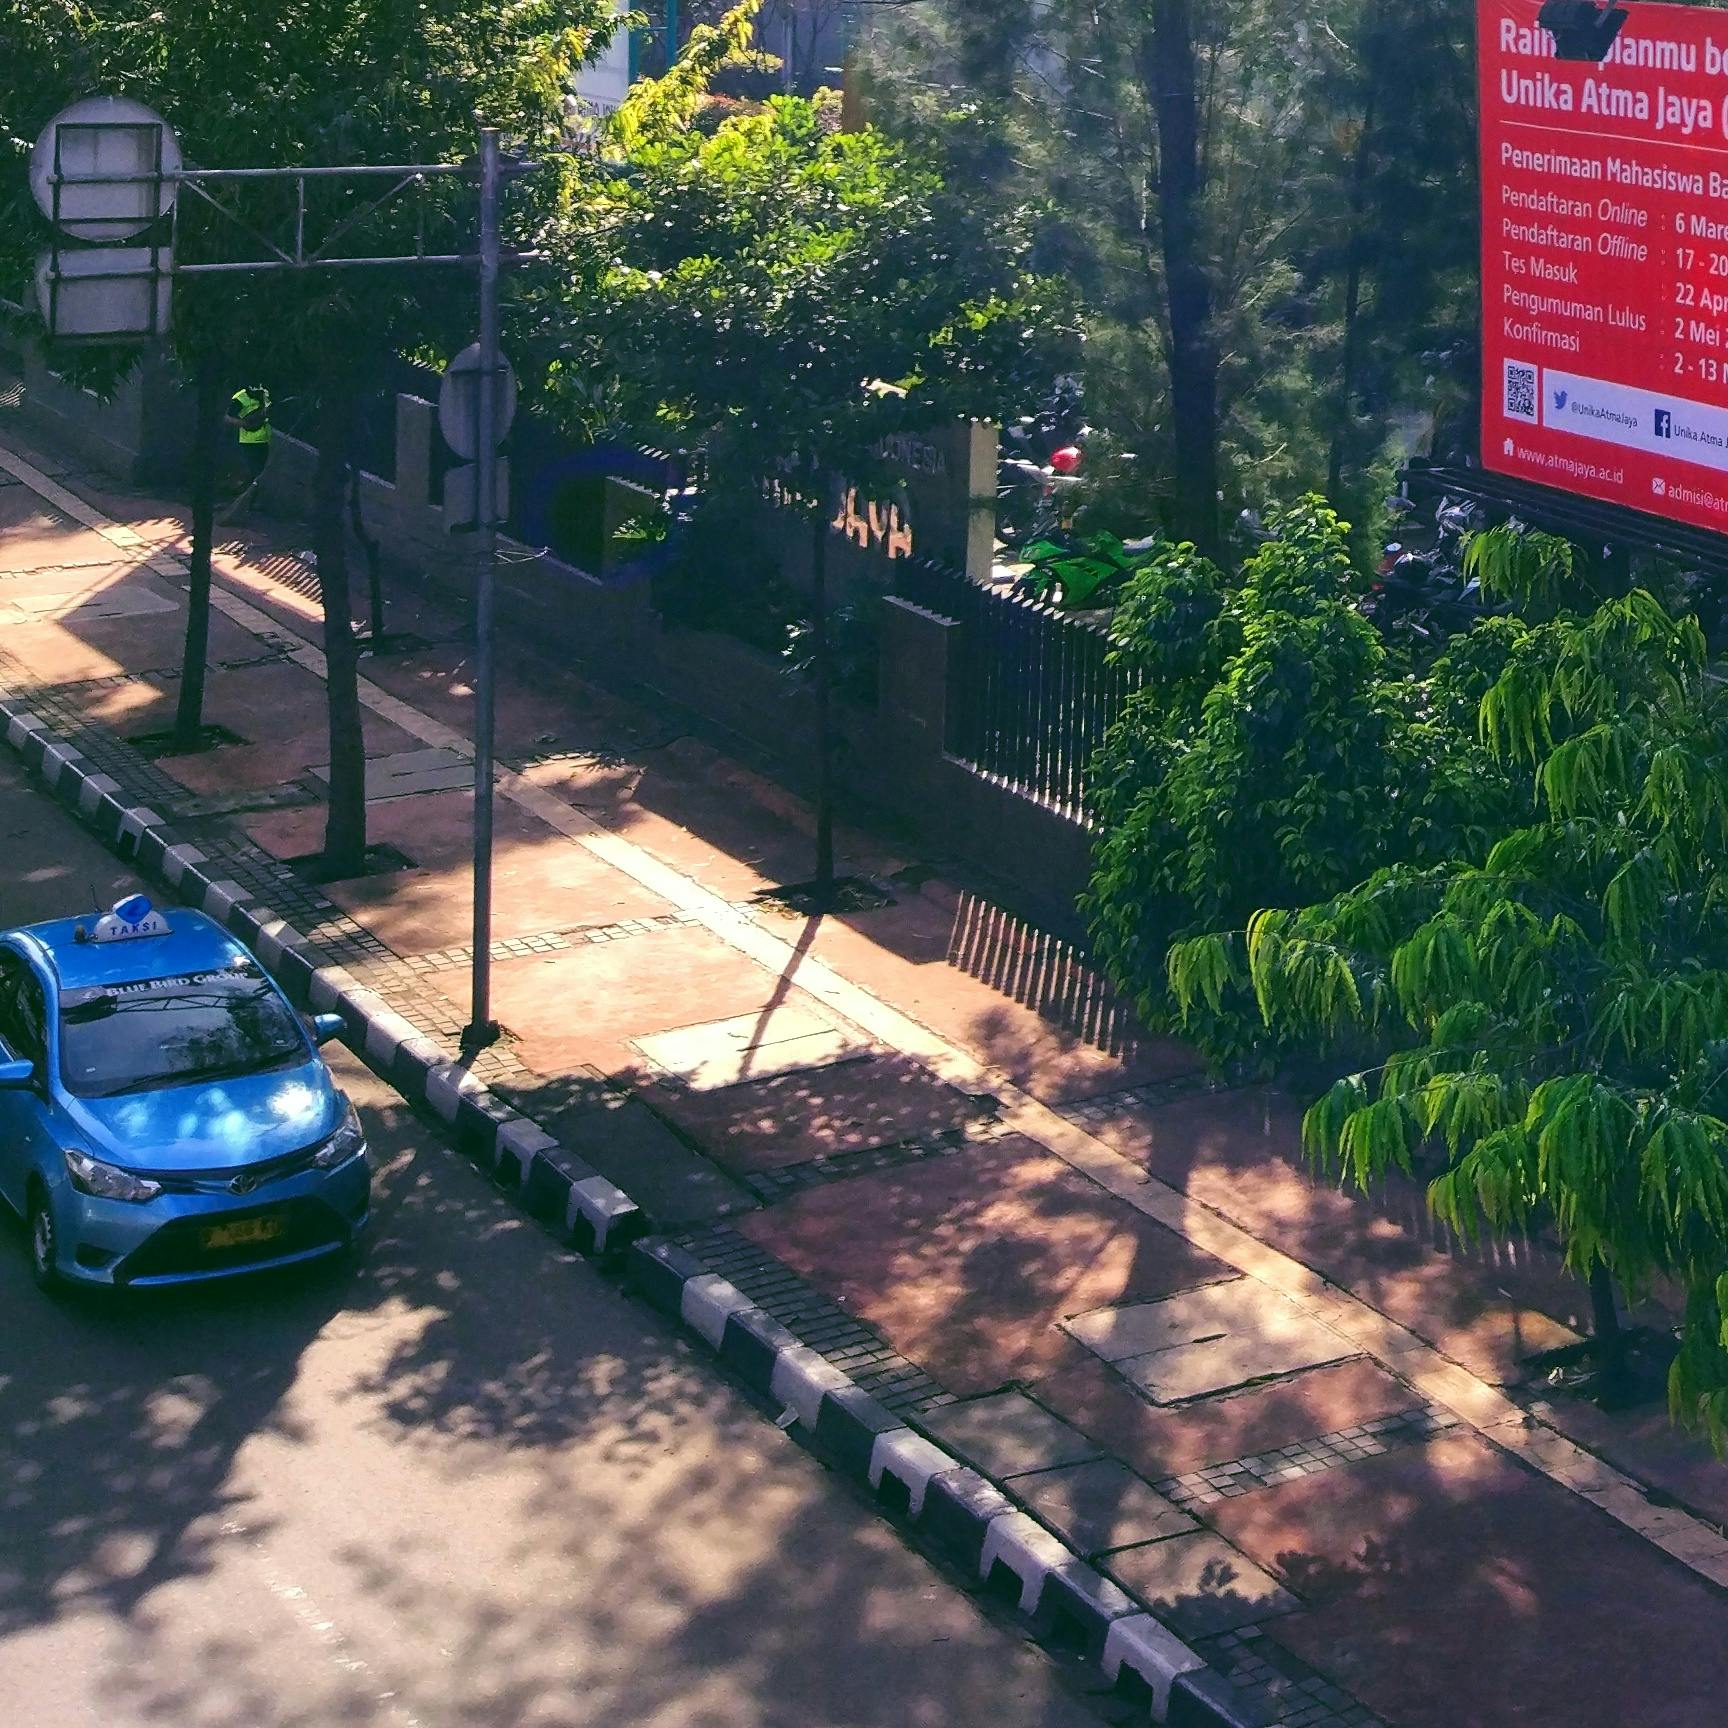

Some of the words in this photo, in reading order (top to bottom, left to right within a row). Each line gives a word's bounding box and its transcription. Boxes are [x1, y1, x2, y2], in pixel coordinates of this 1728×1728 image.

[1501, 68, 1573, 111] Unika
[1580, 78, 1649, 120] Atma
[1655, 86, 1713, 134] Jaya
[1501, 142, 1602, 180] Penerimaan
[1606, 156, 1704, 195] Mahasiswa
[1502, 185, 1592, 218] Pendaftaran
[1597, 198, 1648, 227] Online
[1675, 212, 1686, 233] 6
[1503, 218, 1592, 252] Pendaftaran
[1597, 232, 1648, 261] Offline
[1676, 247, 1694, 270] 17
[1709, 253, 1728, 276] 20
[1503, 251, 1526, 275] Tes
[1530, 256, 1578, 284] Masuk
[1675, 282, 1695, 306] 22
[1503, 284, 1603, 322] Pengumuman
[1608, 304, 1647, 331] Lulus
[1674, 318, 1685, 339] 2
[1689, 320, 1720, 346] Mei
[1503, 317, 1580, 352] Konfirmasi
[1674, 352, 1684, 374] 2
[1699, 358, 1717, 381] 13
[1517, 447, 1623, 484] www.atmajaya.ac.id
[109, 921, 158, 937] TAKSI
